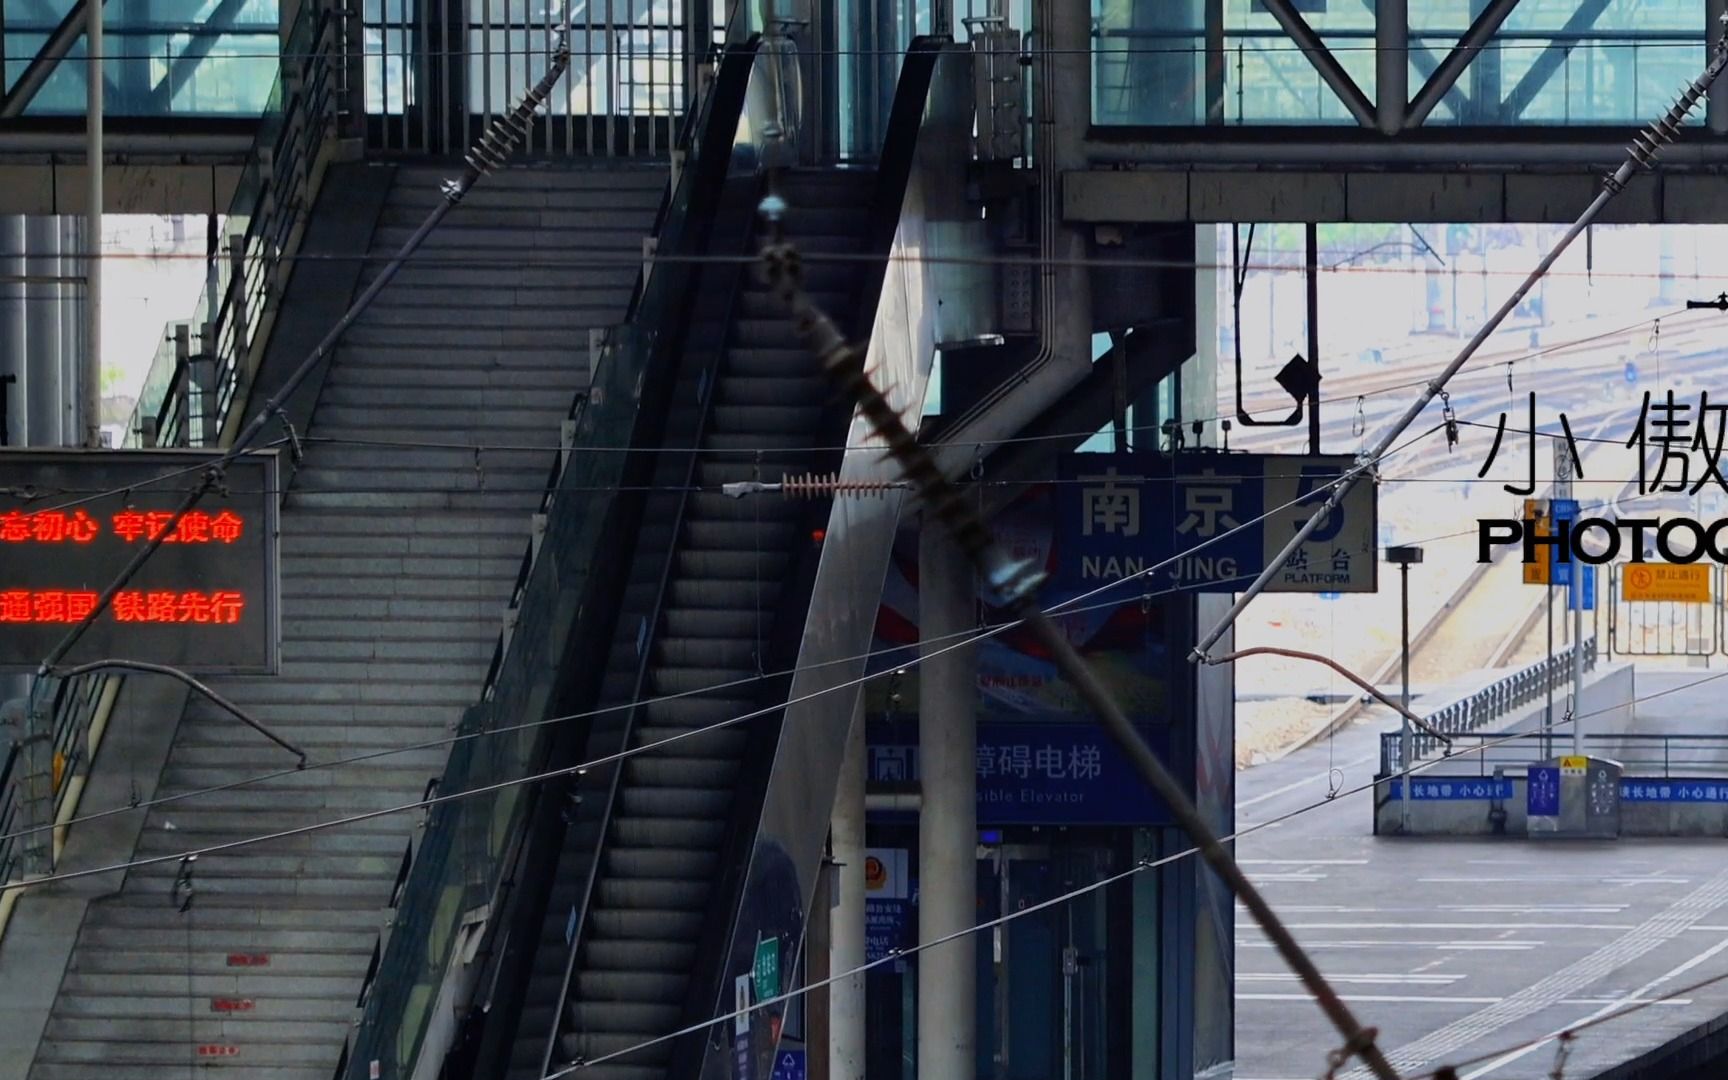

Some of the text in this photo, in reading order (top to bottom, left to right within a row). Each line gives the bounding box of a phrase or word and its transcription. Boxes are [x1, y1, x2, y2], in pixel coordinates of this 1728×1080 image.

[1076, 466, 1243, 537] 南京
[1293, 465, 1345, 542] 5
[0, 511, 243, 543] 忘初心 牢记使命
[1081, 556, 1238, 581] NAN JING
[1284, 572, 1351, 584] PLATFORM
[0, 590, 244, 624] 通强国 铁路先行
[1020, 789, 1085, 804] Elevator
